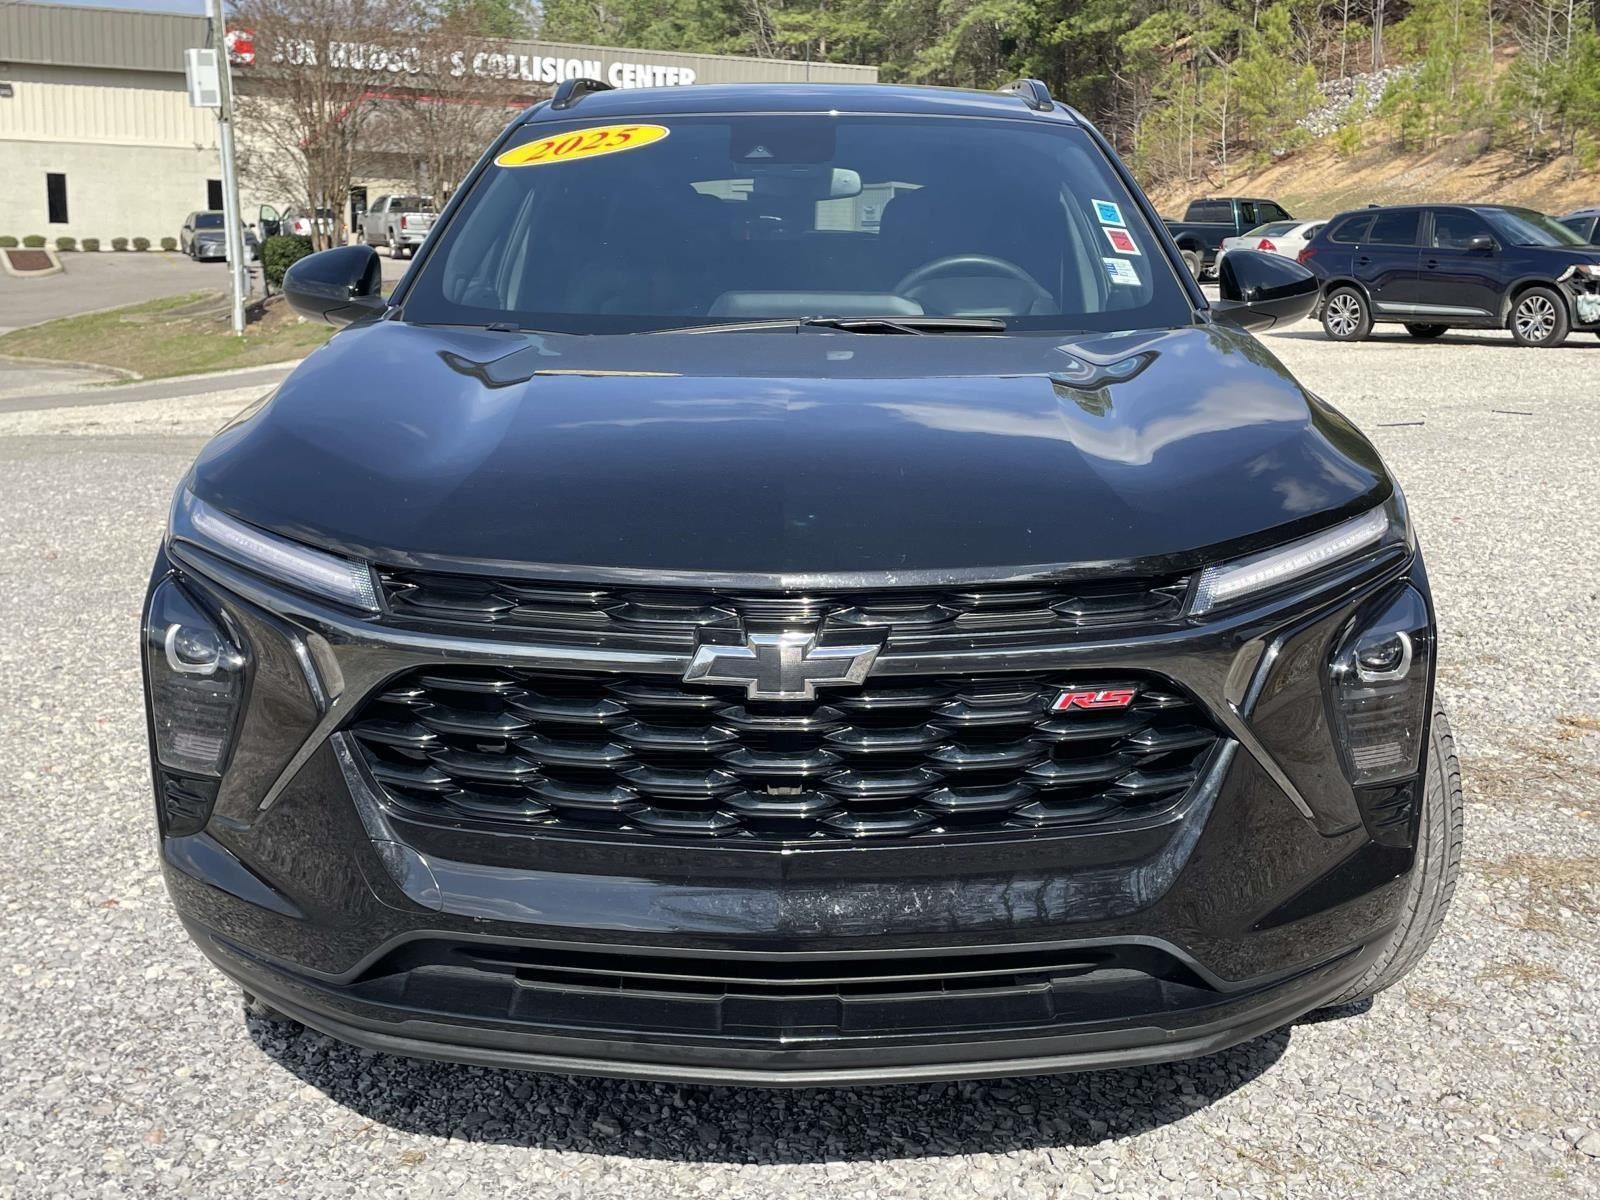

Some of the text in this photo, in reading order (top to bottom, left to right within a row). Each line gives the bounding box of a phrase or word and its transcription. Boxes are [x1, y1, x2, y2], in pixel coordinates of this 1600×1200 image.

[473, 52, 602, 83] COLLISION
[608, 62, 697, 88] CENTER
[522, 127, 640, 162] 2025
[1051, 689, 1135, 711] RS
